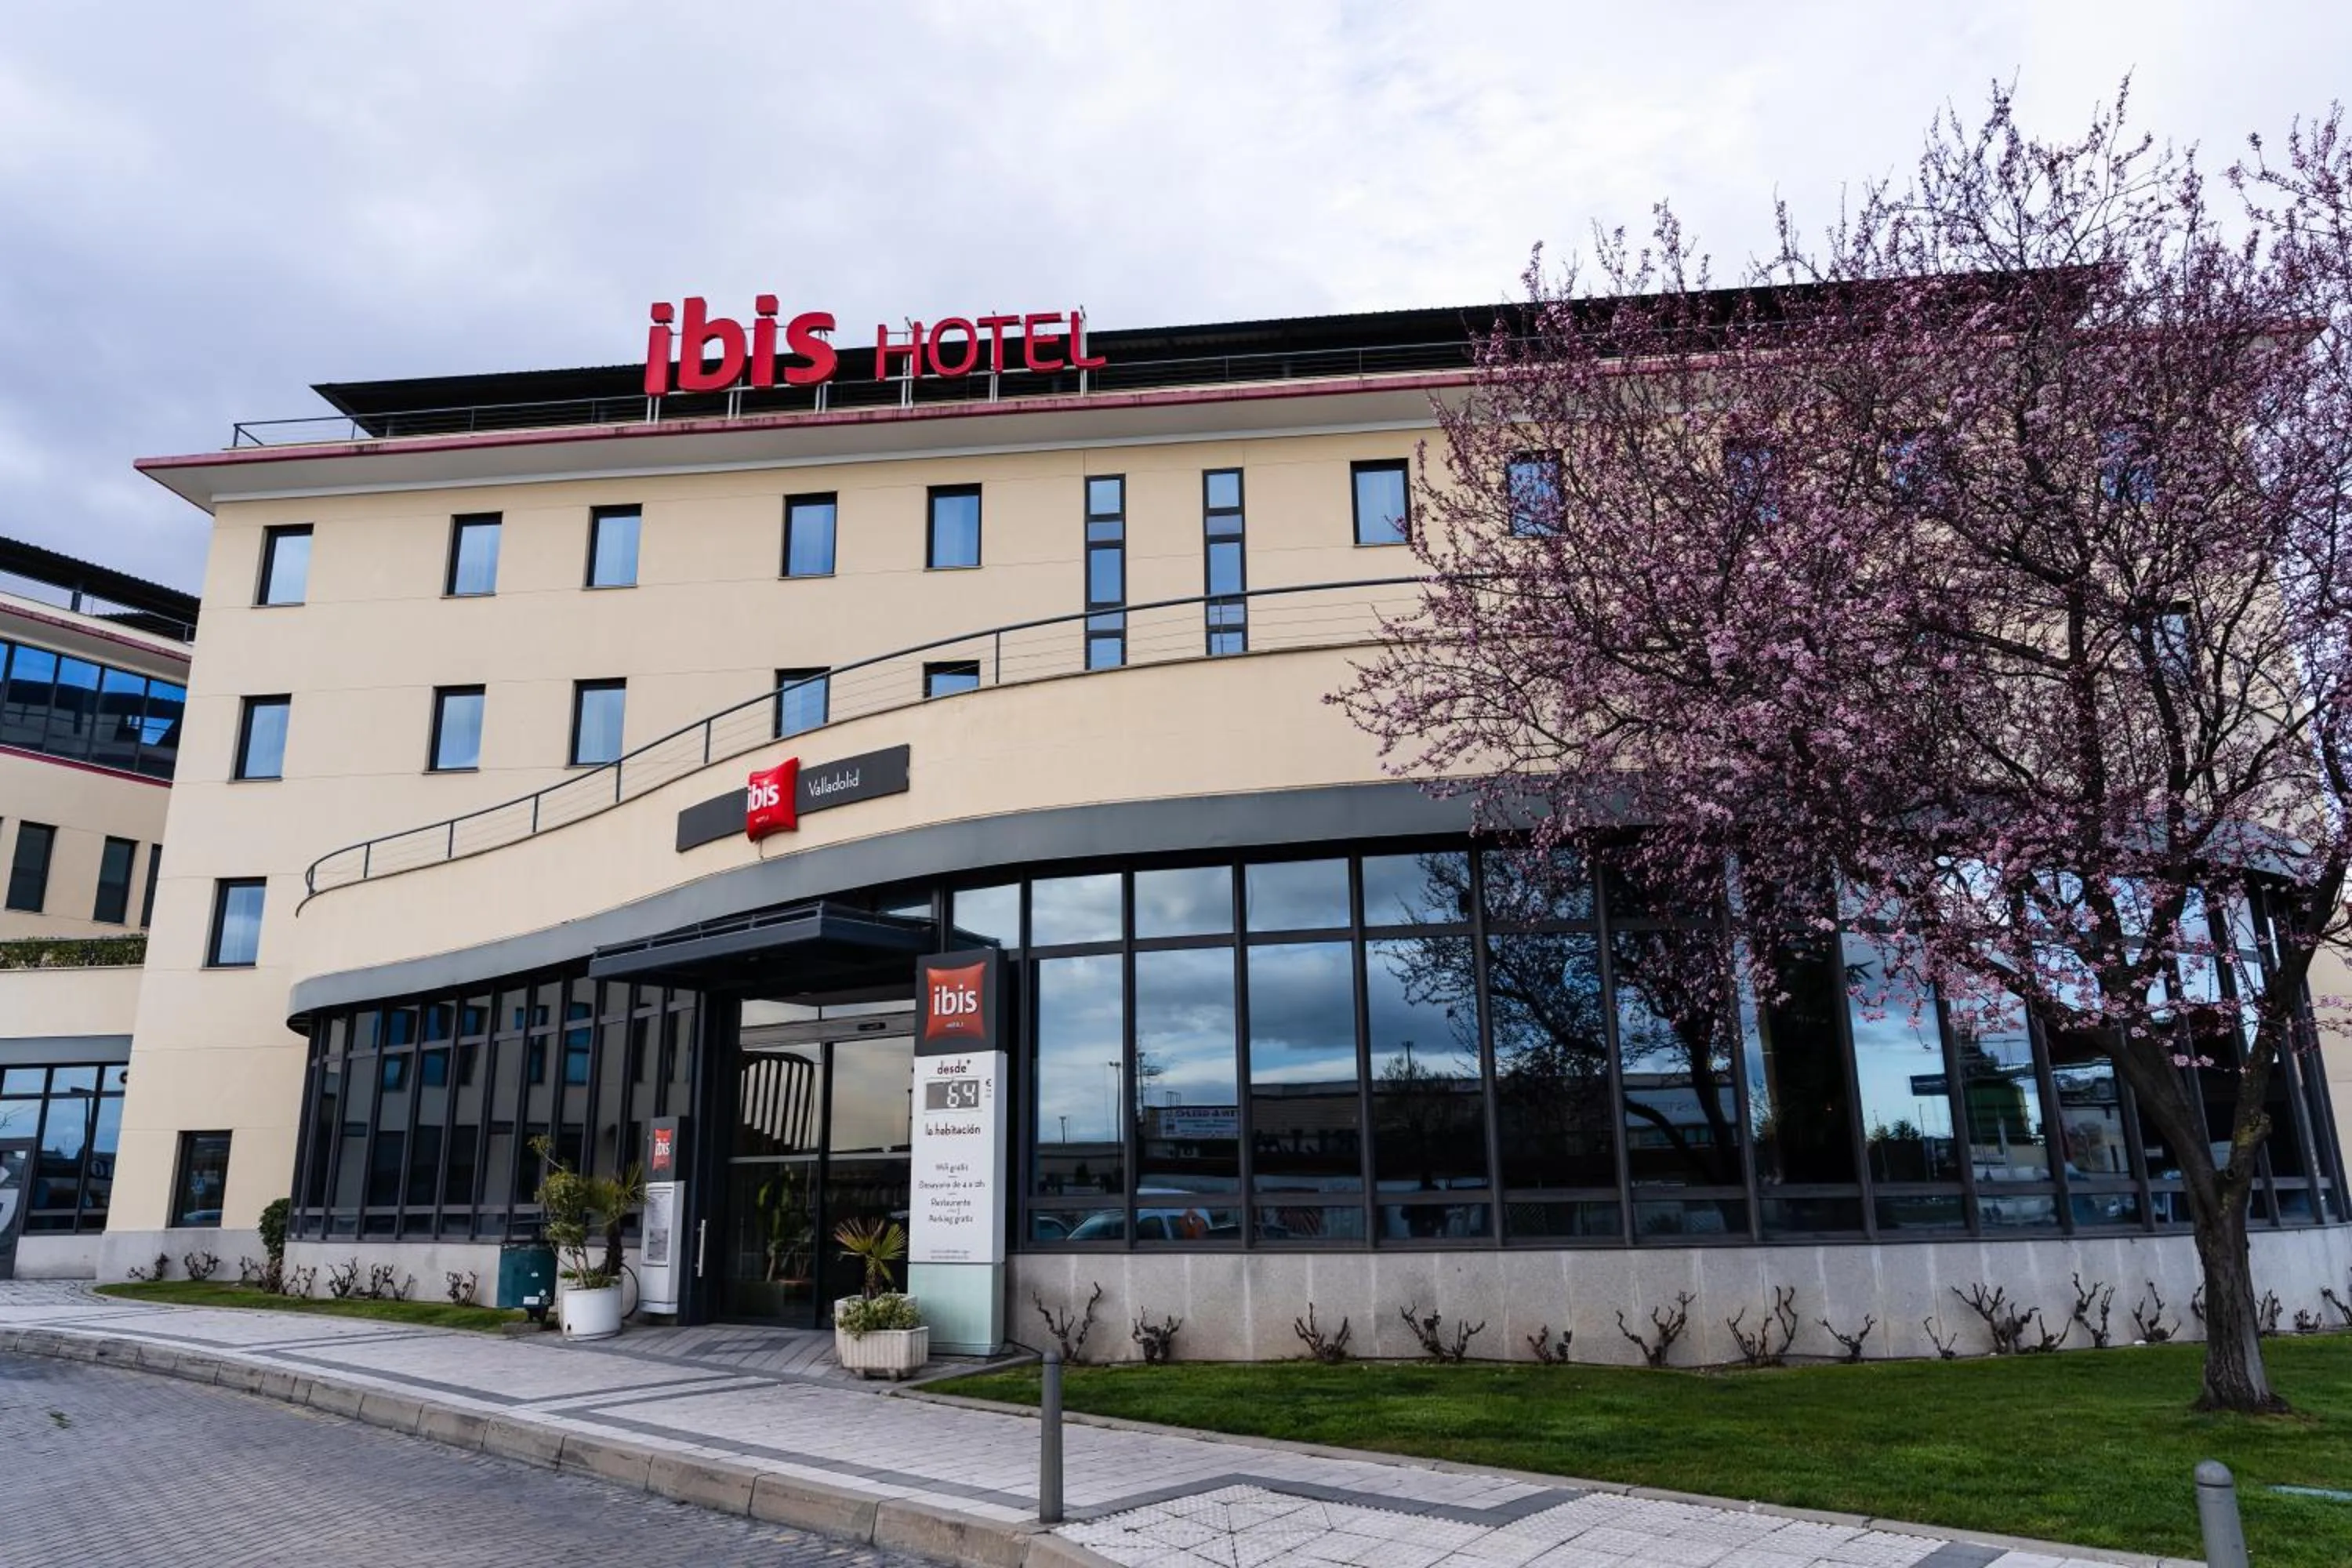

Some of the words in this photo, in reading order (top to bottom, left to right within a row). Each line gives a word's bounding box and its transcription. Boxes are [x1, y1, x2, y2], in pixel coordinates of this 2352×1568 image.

[644, 294, 838, 396] ibis
[876, 310, 1107, 382] HOTEL
[747, 780, 780, 813] ibis
[808, 768, 861, 798] Valladolid
[933, 983, 978, 1016] ibis
[947, 1083, 976, 1108] 64
[925, 1122, 933, 1136] la
[655, 1138, 671, 1157] ibis
